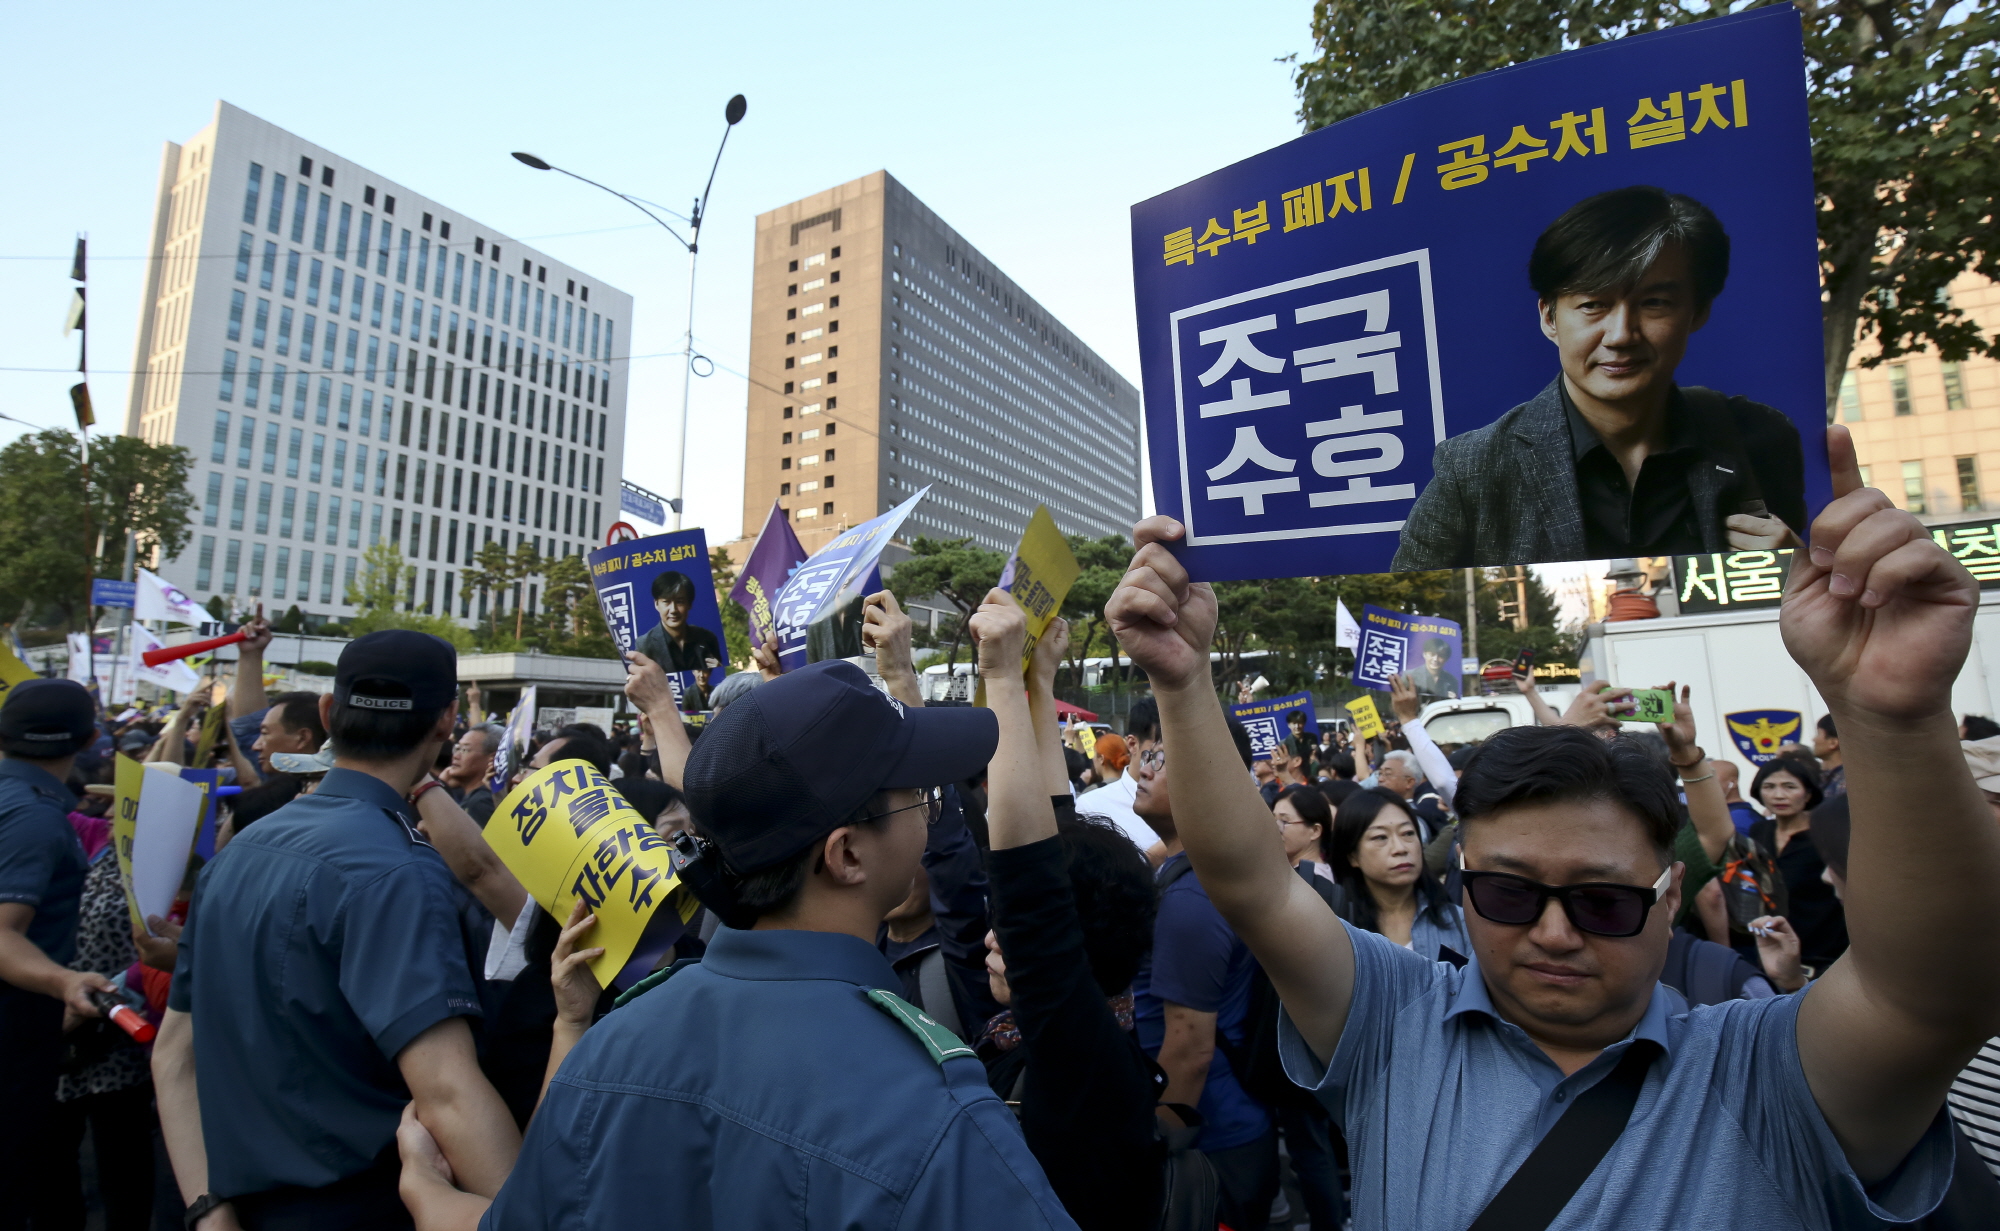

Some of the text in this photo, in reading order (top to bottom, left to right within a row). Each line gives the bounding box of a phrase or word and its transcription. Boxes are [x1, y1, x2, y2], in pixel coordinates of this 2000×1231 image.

[1163, 78, 1748, 266] 특수부 폐지 / 공수처 설치
[1197, 288, 1402, 419] 조국
[1205, 404, 1416, 516] 수호
[631, 549, 667, 568] 공수처
[669, 544, 697, 561] 설치
[780, 567, 840, 606] 조국
[603, 592, 629, 626] 조국
[776, 601, 817, 644] 수호
[1367, 635, 1402, 661] 조국
[1364, 657, 1400, 679] 수호
[355, 696, 408, 709] POLICE
[1245, 721, 1274, 738] 조국
[1250, 737, 1277, 752] 수호
[510, 765, 612, 847] 정치
